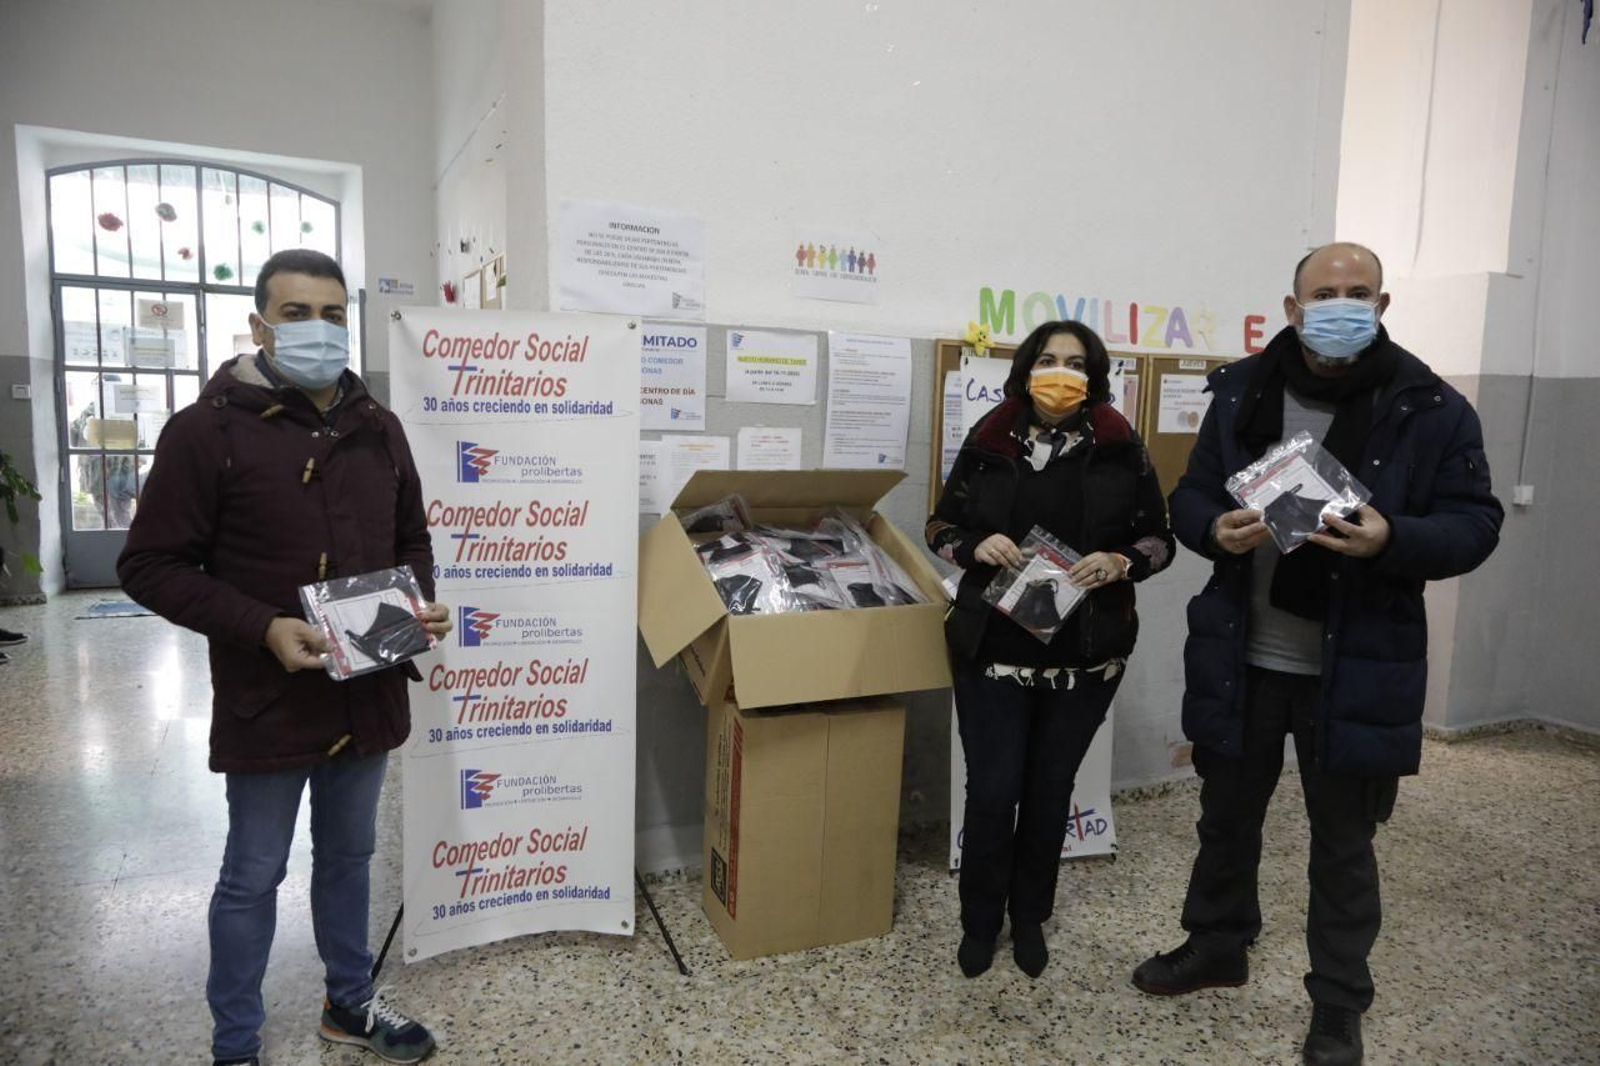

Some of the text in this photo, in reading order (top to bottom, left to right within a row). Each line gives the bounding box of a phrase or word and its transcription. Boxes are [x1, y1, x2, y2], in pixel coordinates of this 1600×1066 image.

[609, 222, 660, 234] INFORMACION
[979, 287, 1217, 350] MOVILIZAR
[423, 329, 589, 362] Comedor Social
[643, 336, 697, 347] MITADO
[448, 365, 567, 397] Trinitarios
[641, 367, 662, 375] ONAS
[966, 377, 1004, 403] CAS
[423, 397, 613, 415] 30 años creciendo en solidaridad
[640, 398, 663, 406] ONAS
[494, 455, 556, 466] FUNDACIÓN
[521, 466, 583, 478] prolibertas
[426, 500, 589, 527] Comedor Social
[451, 534, 567, 563] Trinitarios
[444, 565, 471, 579] años
[475, 564, 532, 579] creciendo
[535, 567, 549, 578] en
[552, 563, 613, 577] solidaridad
[496, 617, 556, 628] FUNDACIÓN
[522, 627, 583, 640] prolibertas
[429, 658, 589, 692] Comedor Social
[453, 694, 567, 724] Trinitarios
[429, 719, 612, 743] 30 años creciendo en solidaridad
[497, 775, 556, 787] FUNDACIÓN
[523, 785, 582, 797] prolibertas
[432, 826, 588, 869] Comedor Social
[456, 861, 567, 898] Trinitarios
[433, 886, 610, 920] 30 años creciendo en solidaridad
